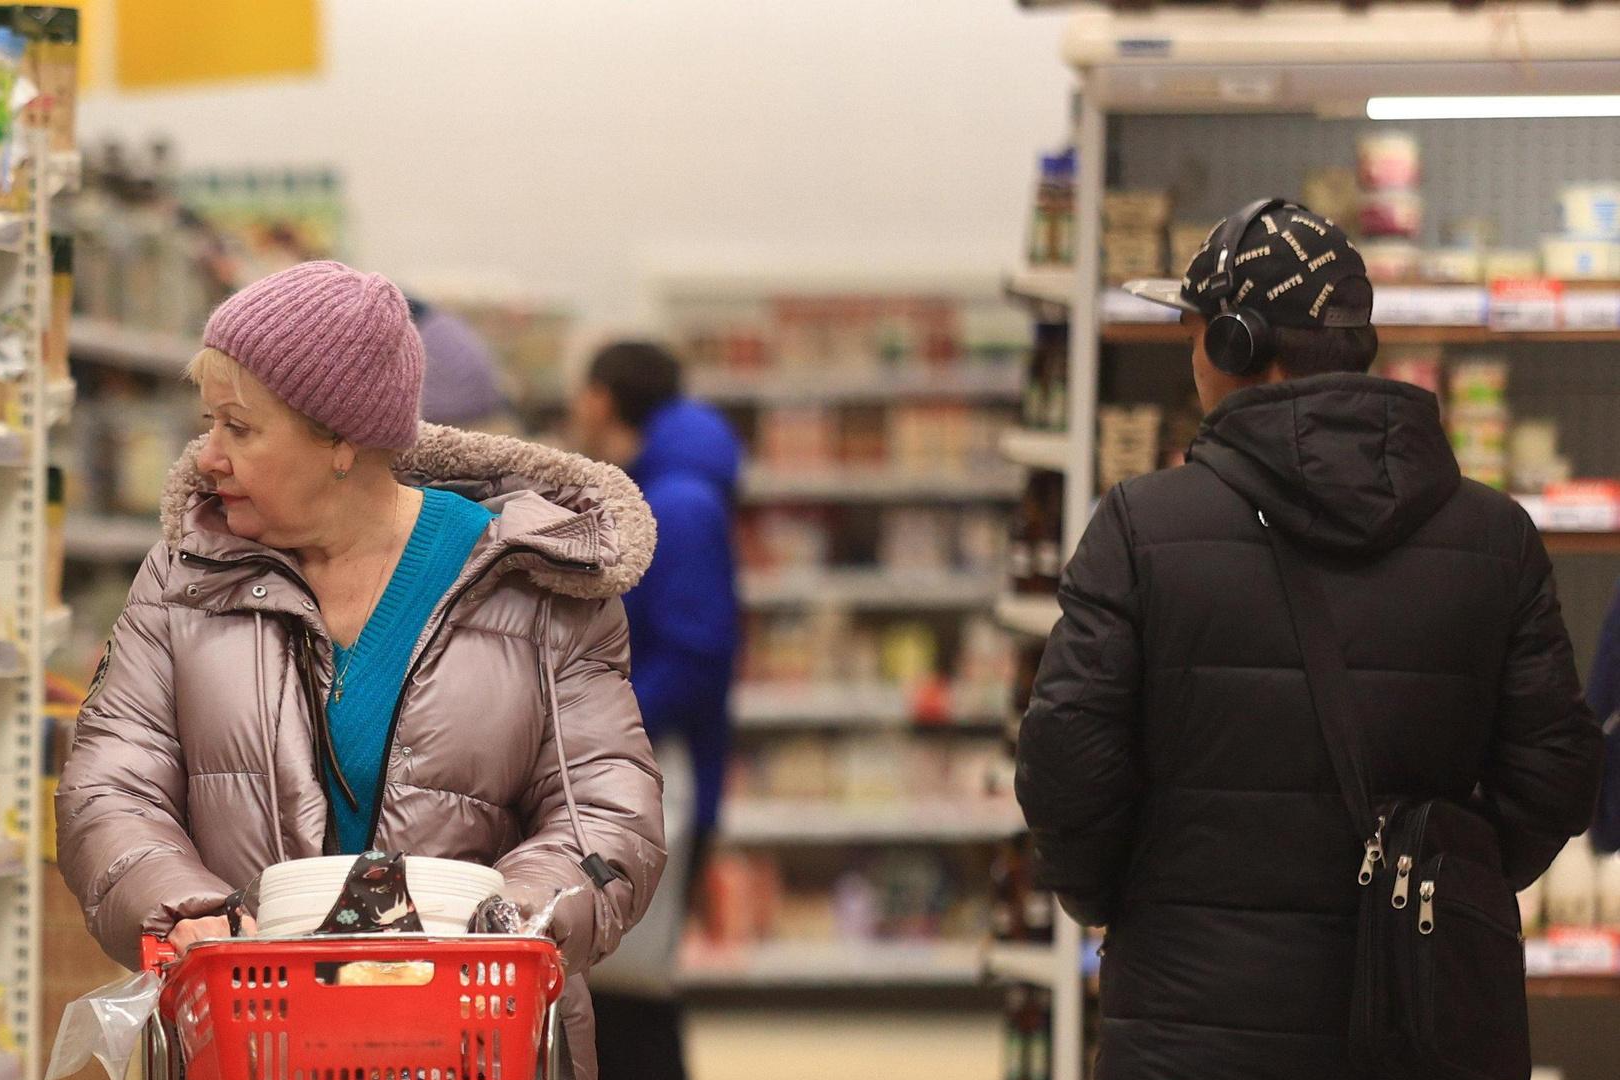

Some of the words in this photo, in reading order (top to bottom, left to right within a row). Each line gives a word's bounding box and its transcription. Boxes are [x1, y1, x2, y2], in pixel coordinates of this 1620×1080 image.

[1234, 244, 1271, 267] SPORTS
[1308, 250, 1337, 273] SPORTS
[1266, 272, 1304, 301] SPORTS
[1309, 282, 1335, 319] SPORTS
